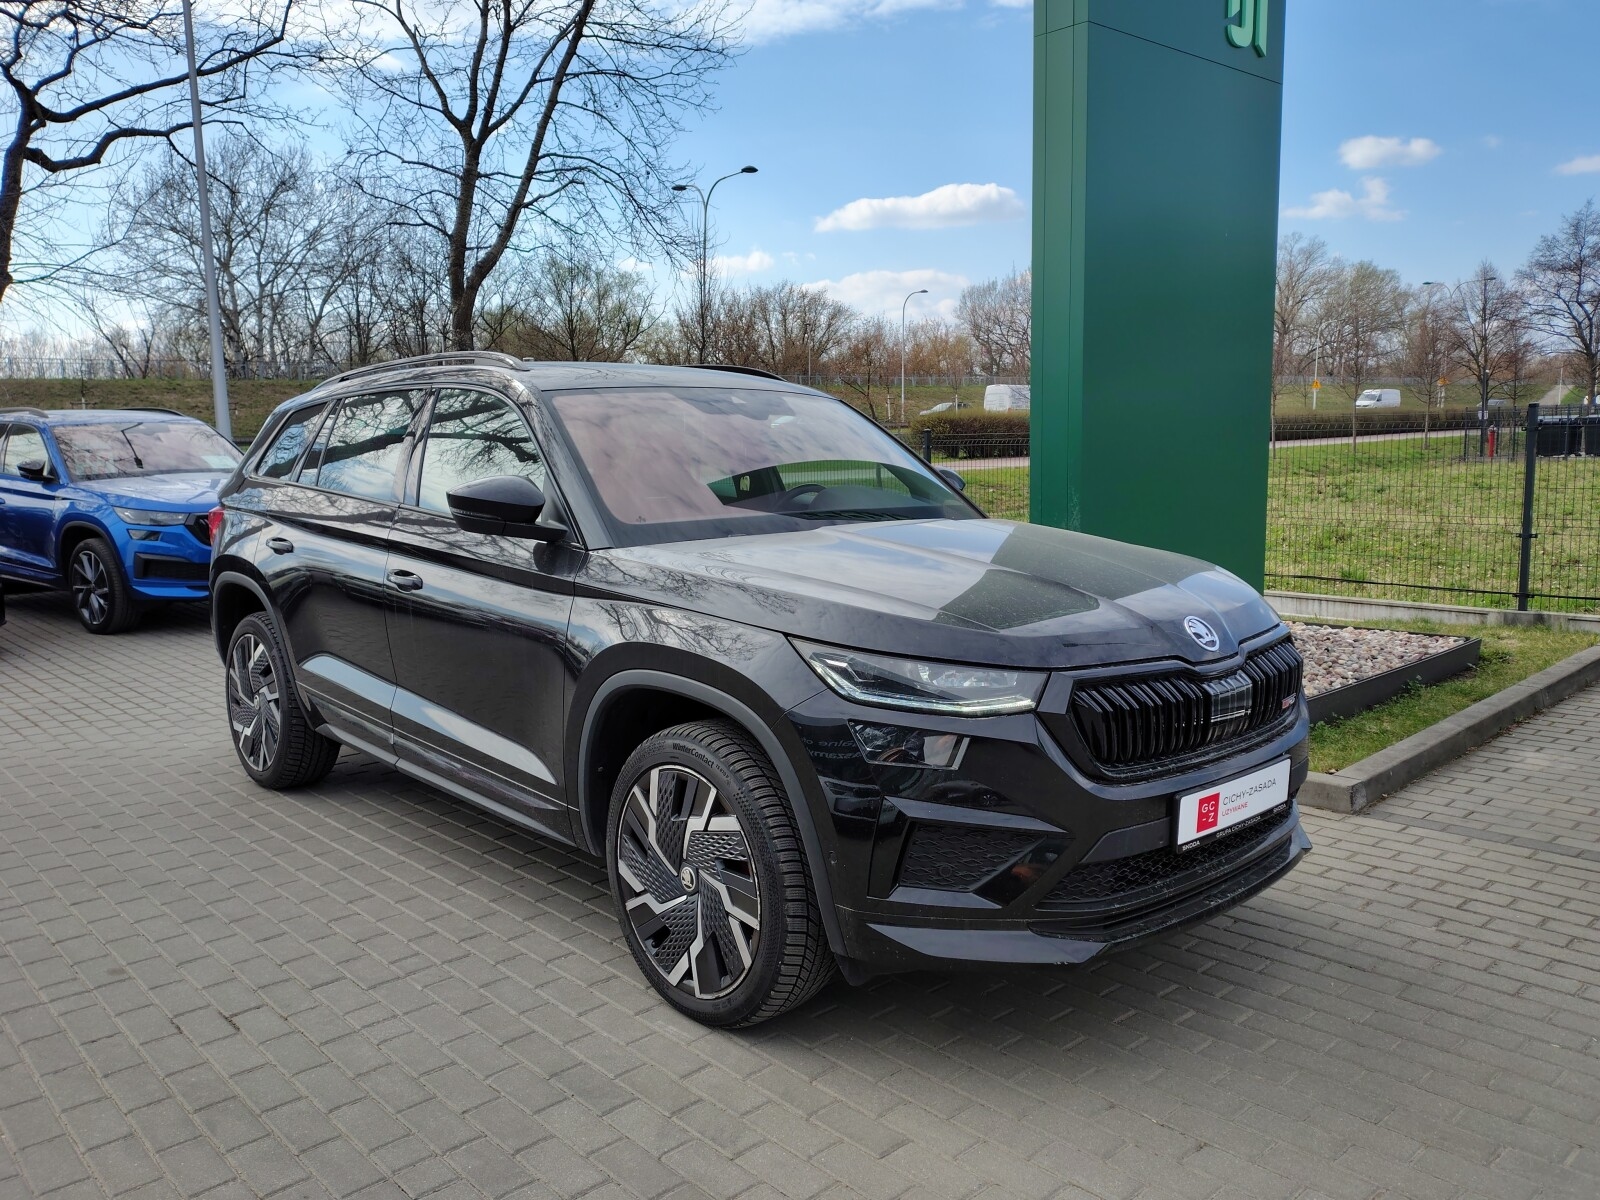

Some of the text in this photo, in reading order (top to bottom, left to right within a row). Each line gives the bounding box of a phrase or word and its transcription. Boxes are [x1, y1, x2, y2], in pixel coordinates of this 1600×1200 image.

[672, 743, 715, 768] WinterContact
[1222, 778, 1277, 806] CICHY-ZASADA
[1201, 801, 1216, 813] GC
